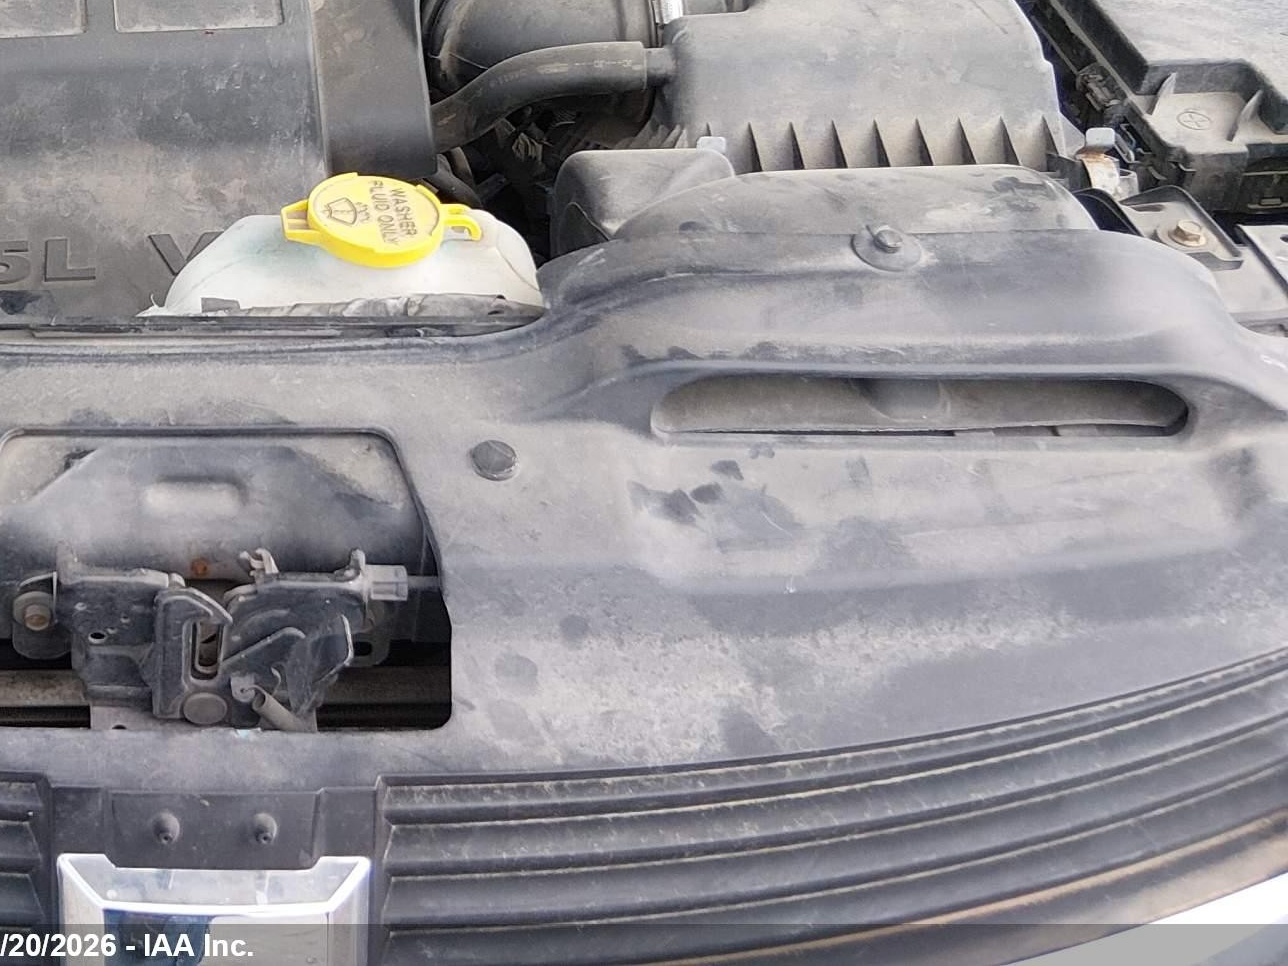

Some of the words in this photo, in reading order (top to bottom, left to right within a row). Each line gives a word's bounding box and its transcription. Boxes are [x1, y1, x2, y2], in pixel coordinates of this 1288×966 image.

[368, 179, 387, 214] FLUID
[389, 187, 419, 237] WASHER
[376, 214, 401, 246] ONLY
